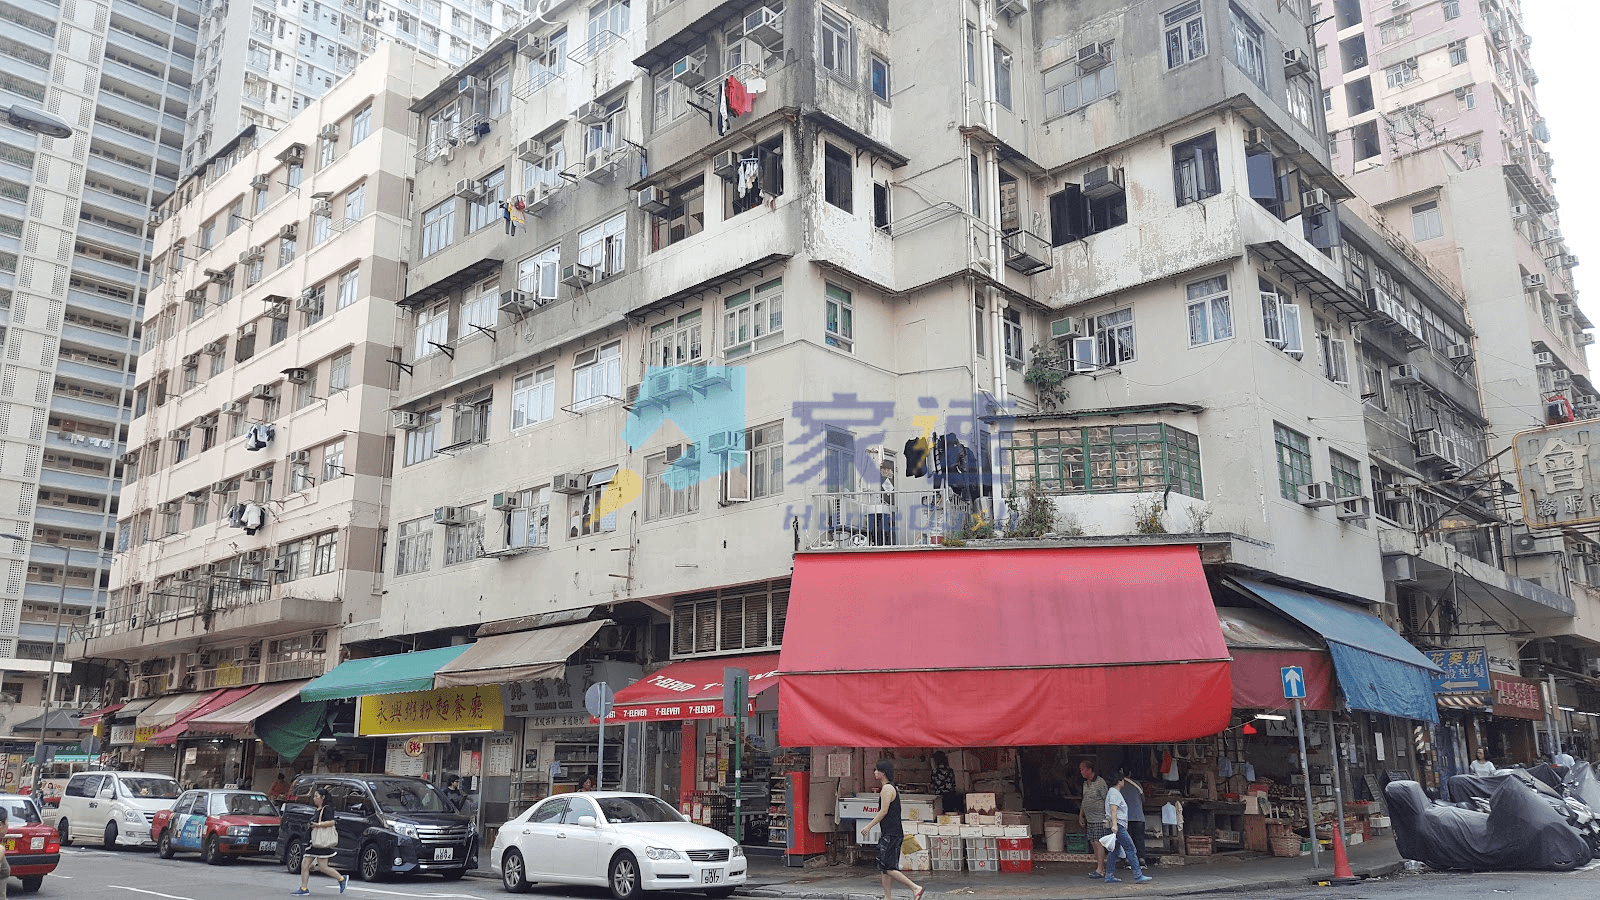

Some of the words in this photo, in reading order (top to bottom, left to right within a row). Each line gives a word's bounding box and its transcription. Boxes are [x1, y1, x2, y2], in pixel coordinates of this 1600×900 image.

[1529, 437, 1590, 495] 會
[647, 675, 696, 692] 7-ELEVEN
[535, 702, 556, 710] DRAGON
[558, 701, 573, 709] CAKE
[689, 705, 715, 714] 7-ELEVEN
[624, 709, 647, 718] 7-ELEVEN
[655, 707, 680, 715] 7-ELEVEN
